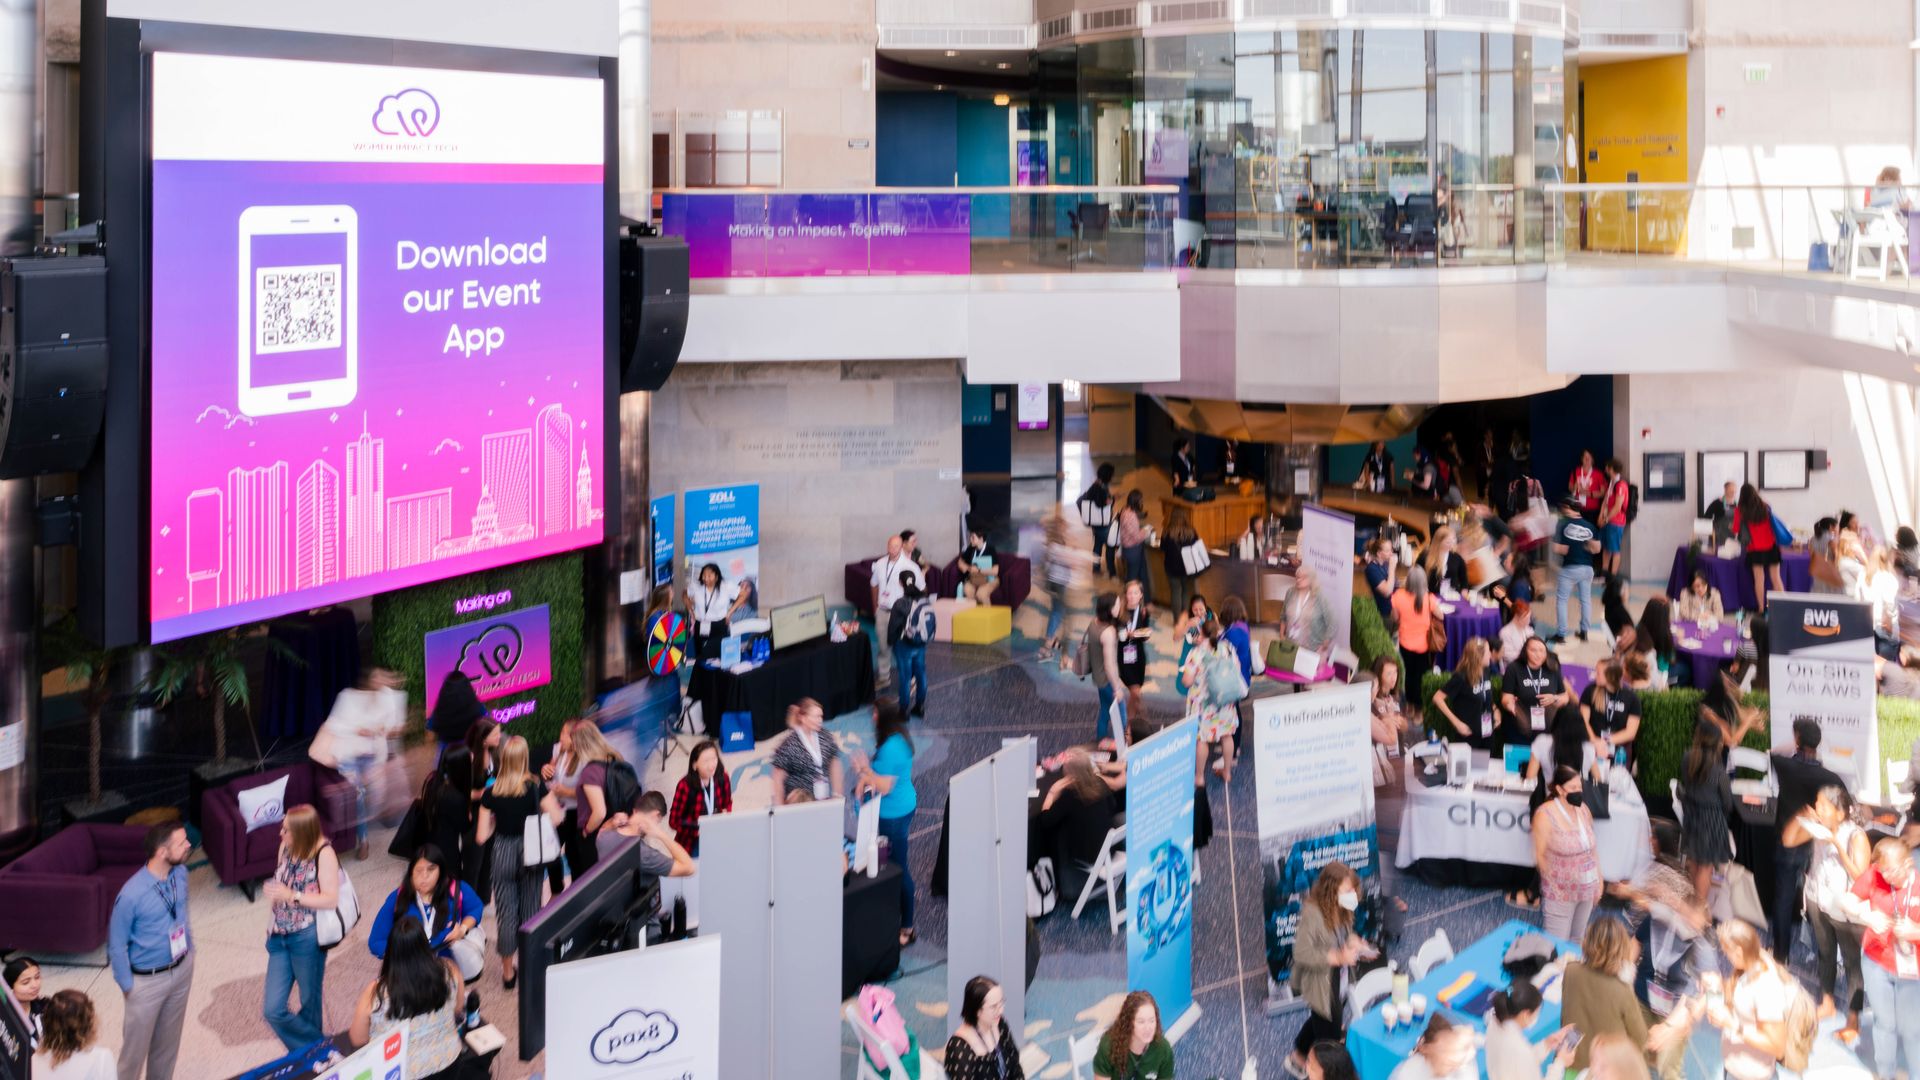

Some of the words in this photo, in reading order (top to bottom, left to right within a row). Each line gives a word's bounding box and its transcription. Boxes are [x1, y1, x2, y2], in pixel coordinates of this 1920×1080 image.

[353, 143, 393, 151] WOMEN
[729, 223, 774, 239] Making
[778, 225, 795, 236] an
[797, 224, 846, 239] Impact,
[397, 235, 547, 271] Download
[403, 287, 454, 314] our
[462, 278, 541, 310] Event
[442, 323, 505, 359] App
[709, 491, 735, 504] ZOLL
[699, 516, 746, 529] DEVELOPING
[456, 594, 494, 614] Making
[496, 590, 511, 604] an
[1803, 608, 1839, 627] aws
[1787, 662, 1860, 681] On-Site
[1787, 682, 1815, 697] Ask
[1820, 682, 1861, 700] AWS
[493, 701, 535, 723] Together
[1284, 702, 1356, 726] theTradeDesk
[1141, 731, 1192, 771] theTradeDesk
[1447, 799, 1531, 833] choo
[608, 1023, 660, 1054] pax8
